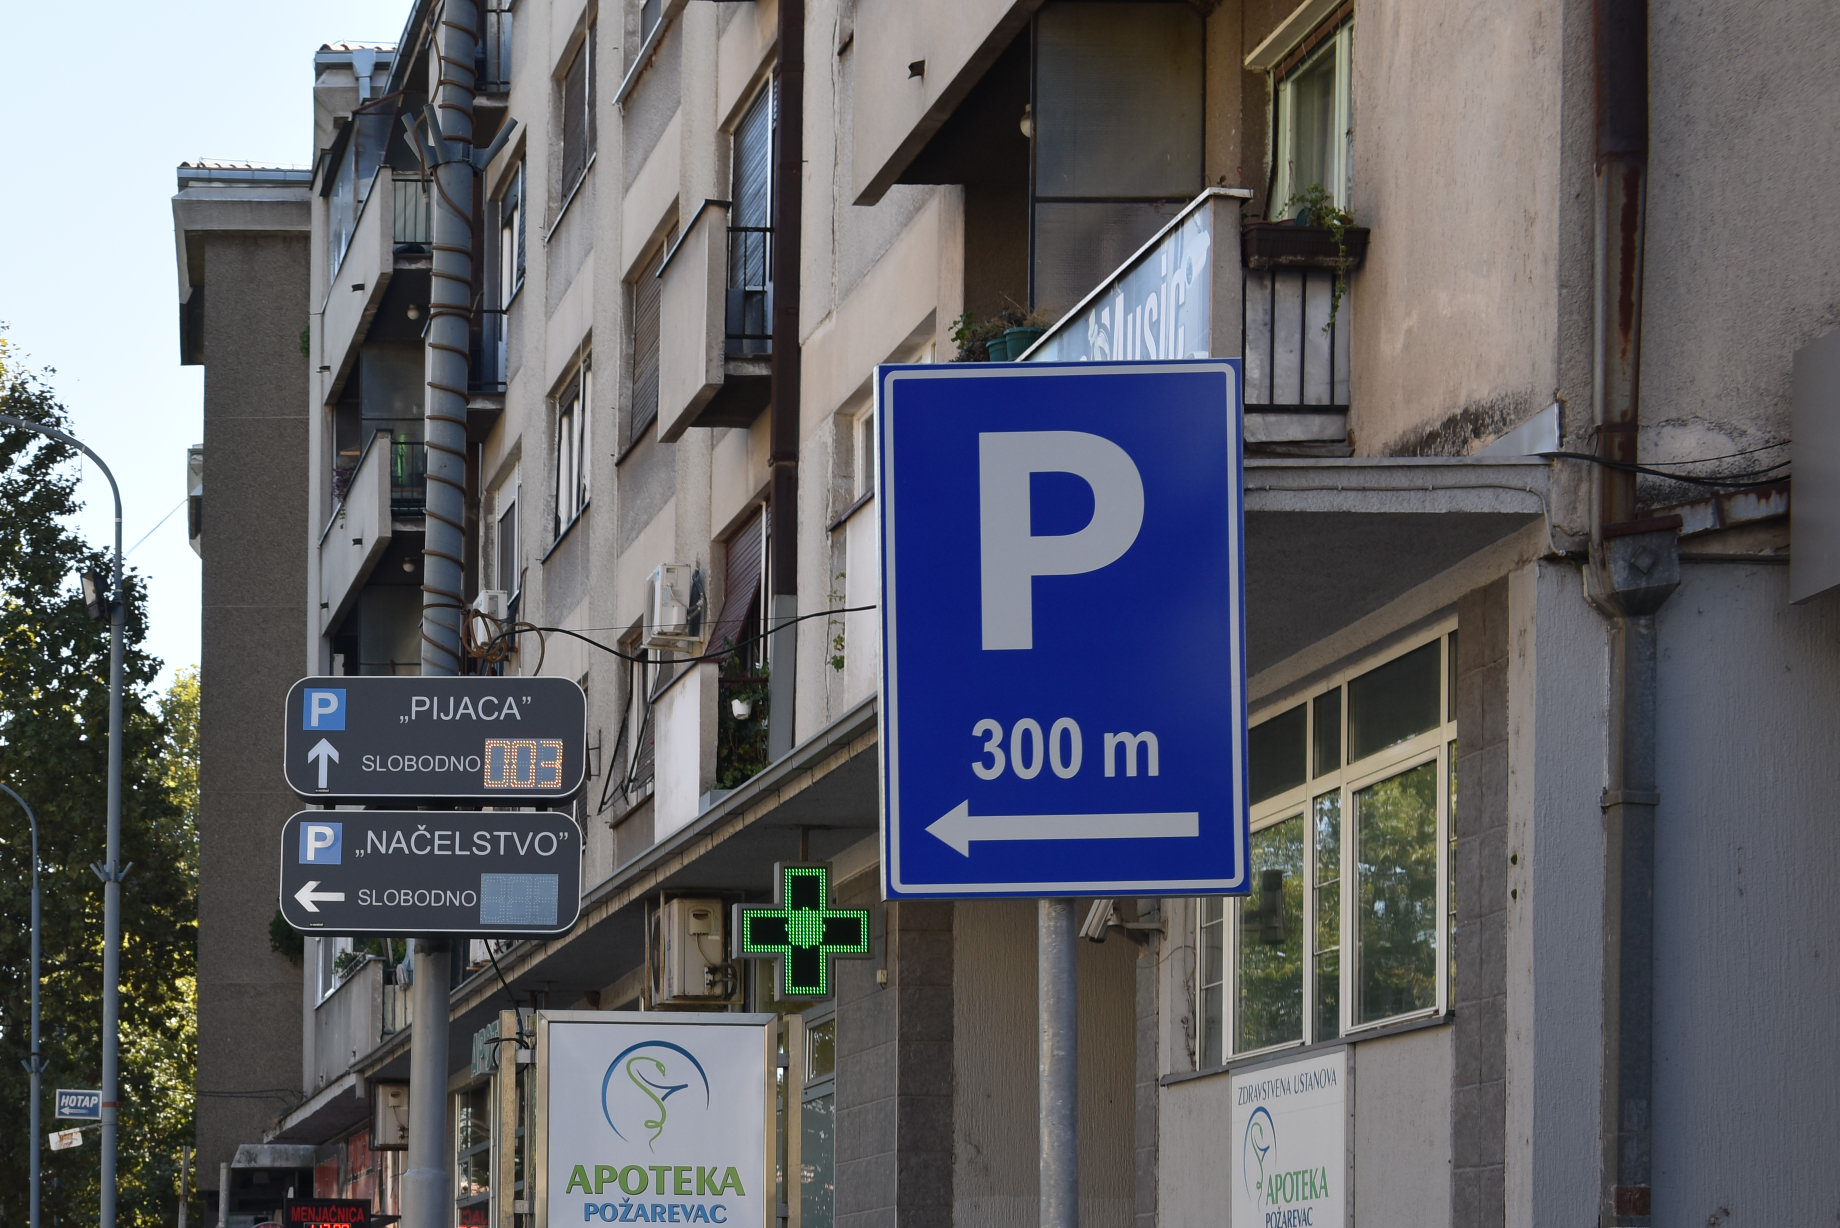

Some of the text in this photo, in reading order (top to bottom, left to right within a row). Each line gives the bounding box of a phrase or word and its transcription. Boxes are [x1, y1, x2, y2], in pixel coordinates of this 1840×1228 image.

[979, 431, 1145, 650] P
[311, 692, 338, 727] P
[361, 755, 481, 772] SLOBODNO
[483, 740, 563, 788] 003
[971, 717, 1160, 780] 300 m
[306, 825, 335, 861] P
[357, 889, 477, 908] SLOBODNO
[1238, 1067, 1337, 1106] ZDRAVSTVENA USTANOVA
[566, 1164, 746, 1196] APOTEKA
[1266, 1166, 1329, 1206] APOTEKA
[584, 1197, 727, 1224] POŽAREVAC
